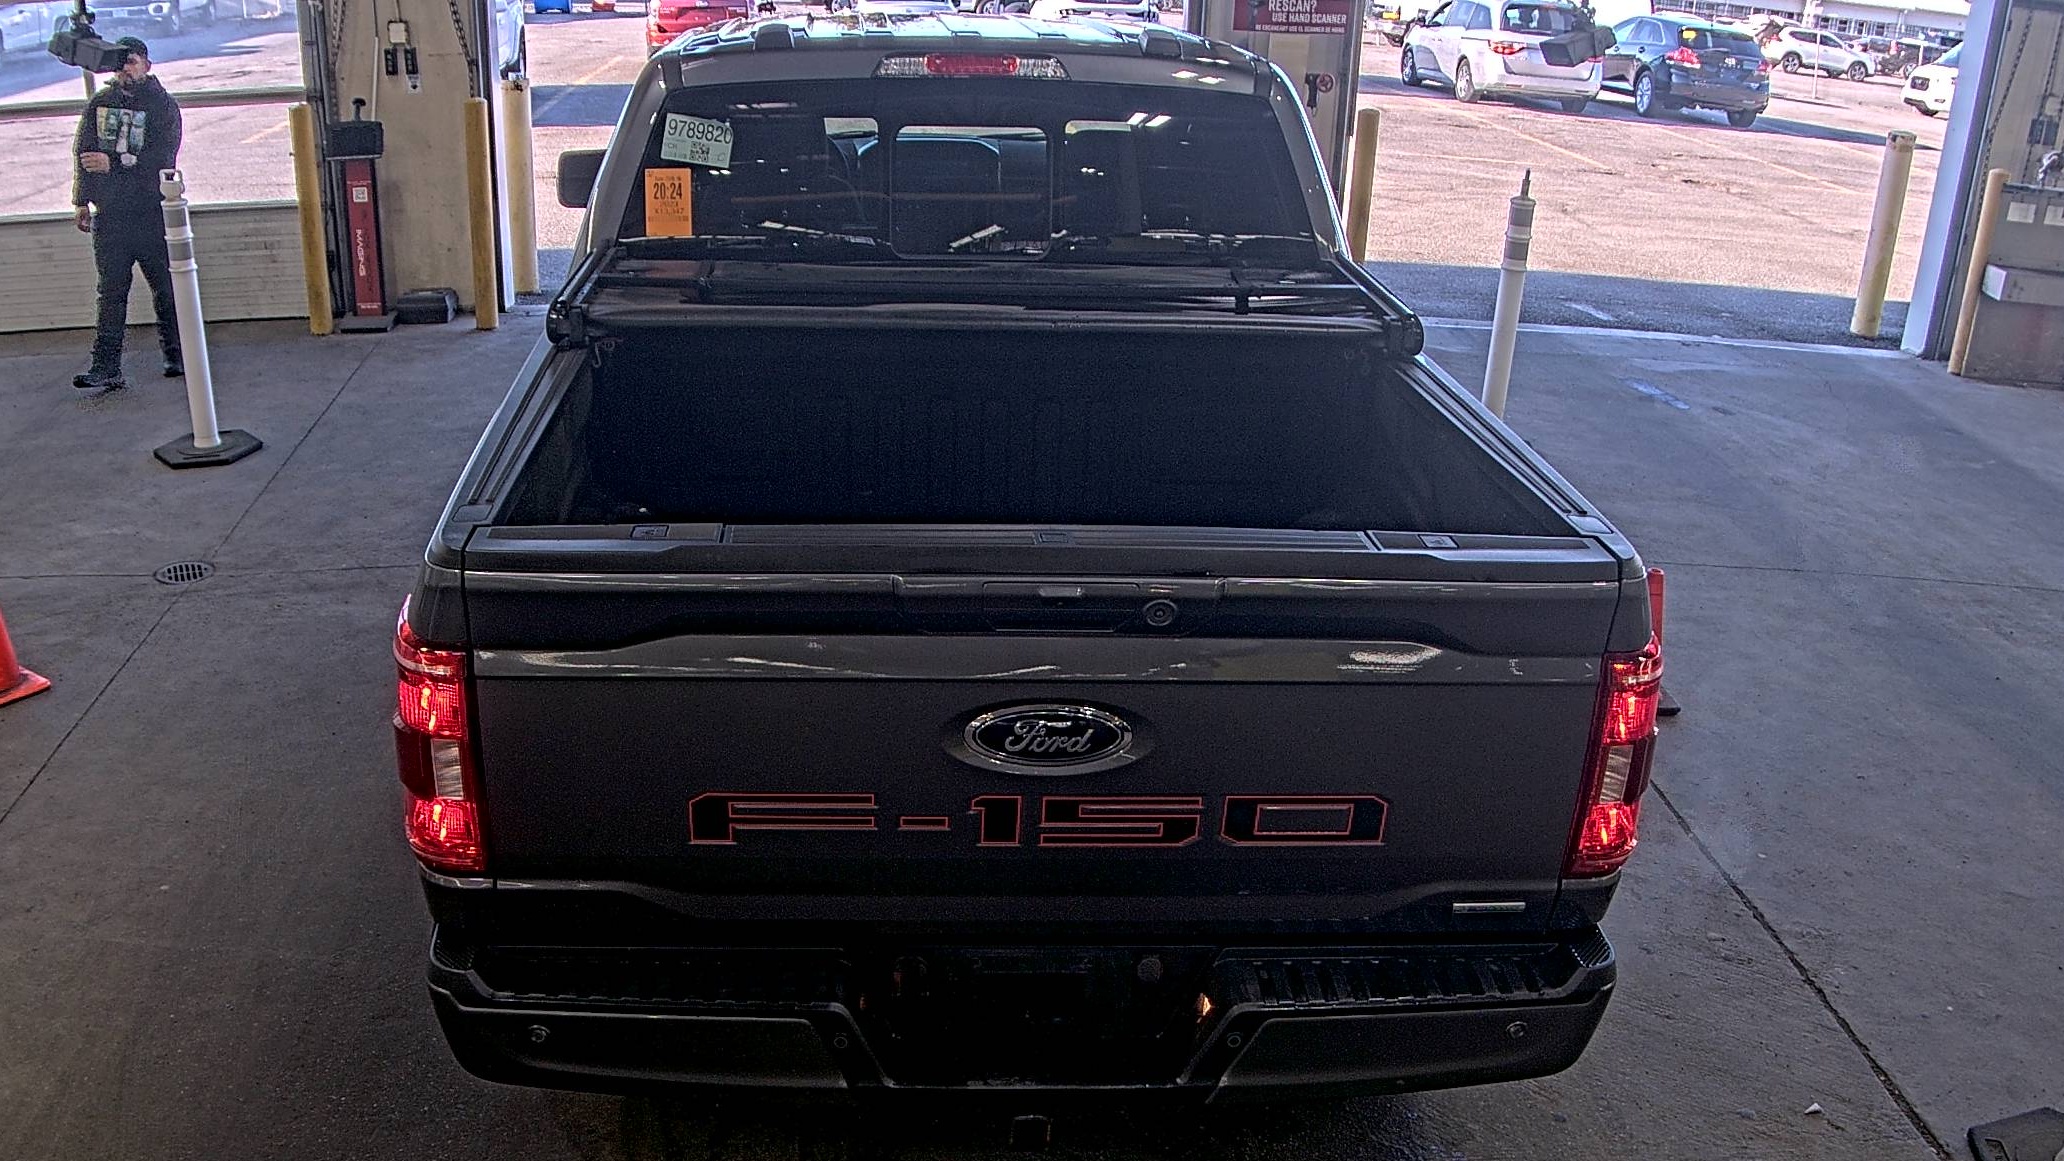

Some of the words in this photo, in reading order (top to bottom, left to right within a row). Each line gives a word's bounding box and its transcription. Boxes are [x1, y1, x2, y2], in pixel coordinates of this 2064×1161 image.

[1268, 0, 1317, 12] RESCAN?
[1272, 12, 1287, 22] USE
[1289, 13, 1310, 23] HAND
[1311, 13, 1347, 24] SCANNER
[668, 118, 733, 145] 9789820
[1005, 719, 1095, 753] Ford
[689, 793, 1389, 846] F-150
